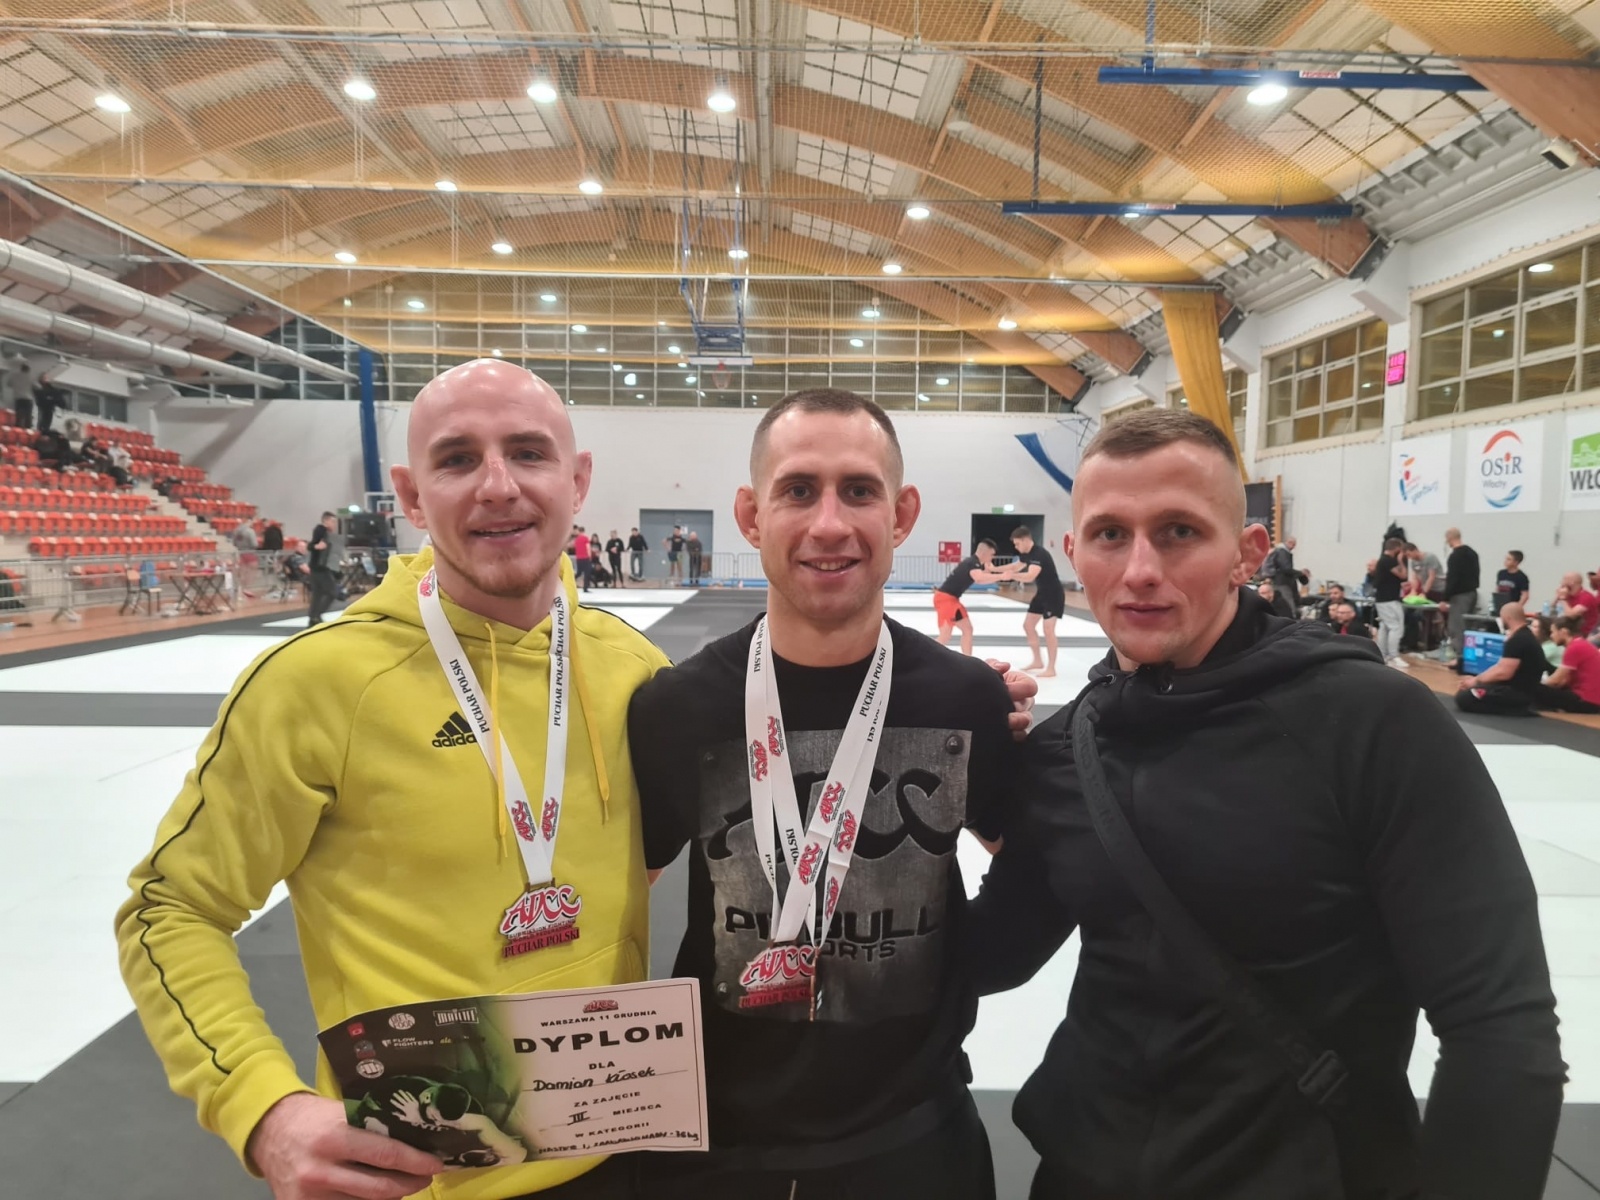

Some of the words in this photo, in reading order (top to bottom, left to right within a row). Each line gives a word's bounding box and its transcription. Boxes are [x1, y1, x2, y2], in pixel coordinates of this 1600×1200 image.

[449, 658, 472, 693] POLSKI
[859, 680, 878, 717] PUCHAR
[873, 647, 887, 680] POLSKI
[466, 693, 490, 733] PUCHAR
[554, 688, 563, 727] PUCHAR
[432, 734, 477, 748] adida
[500, 885, 582, 934] ADCC
[725, 905, 940, 943] PIBULL
[504, 938, 544, 958] PUCHAR
[546, 928, 580, 947] POLSKI
[822, 940, 896, 961] ORTS
[541, 1016, 596, 1027] WARSZAWA
[613, 1009, 657, 1019] GRUDNIA
[513, 1022, 684, 1054] DYPLOM
[588, 1061, 616, 1070] DLA
[533, 1077, 594, 1092] Damian
[592, 1091, 641, 1105] ZAJĘCIE
[612, 1103, 662, 1116] MIEJSCA
[588, 1121, 650, 1137] KATEGORII
